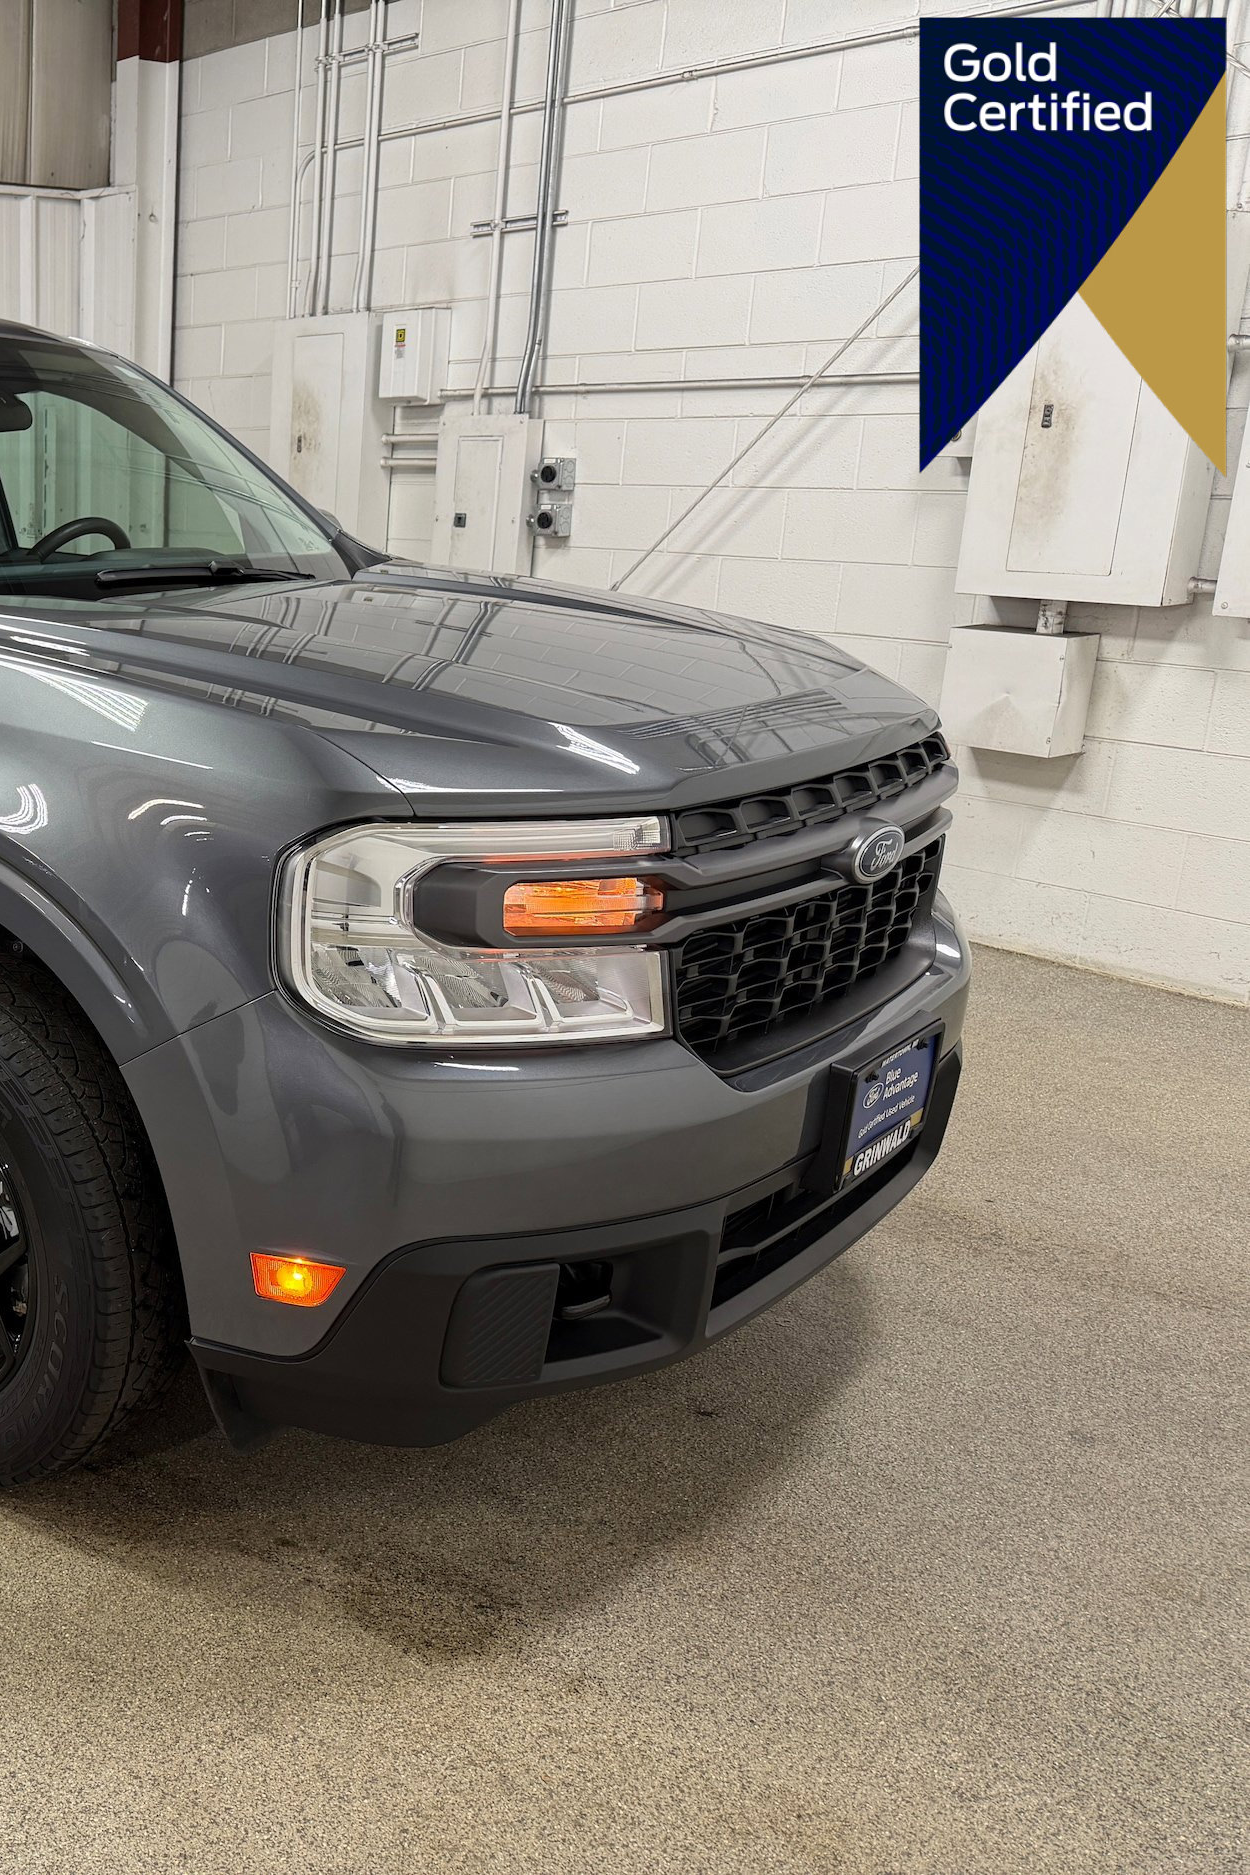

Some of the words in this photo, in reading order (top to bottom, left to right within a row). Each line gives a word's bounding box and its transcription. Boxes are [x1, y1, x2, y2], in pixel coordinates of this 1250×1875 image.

[883, 1072, 918, 1100] Advantage
[886, 1068, 901, 1085] Blue
[885, 1103, 899, 1118] Used
[853, 1120, 910, 1176] GRINWALD
